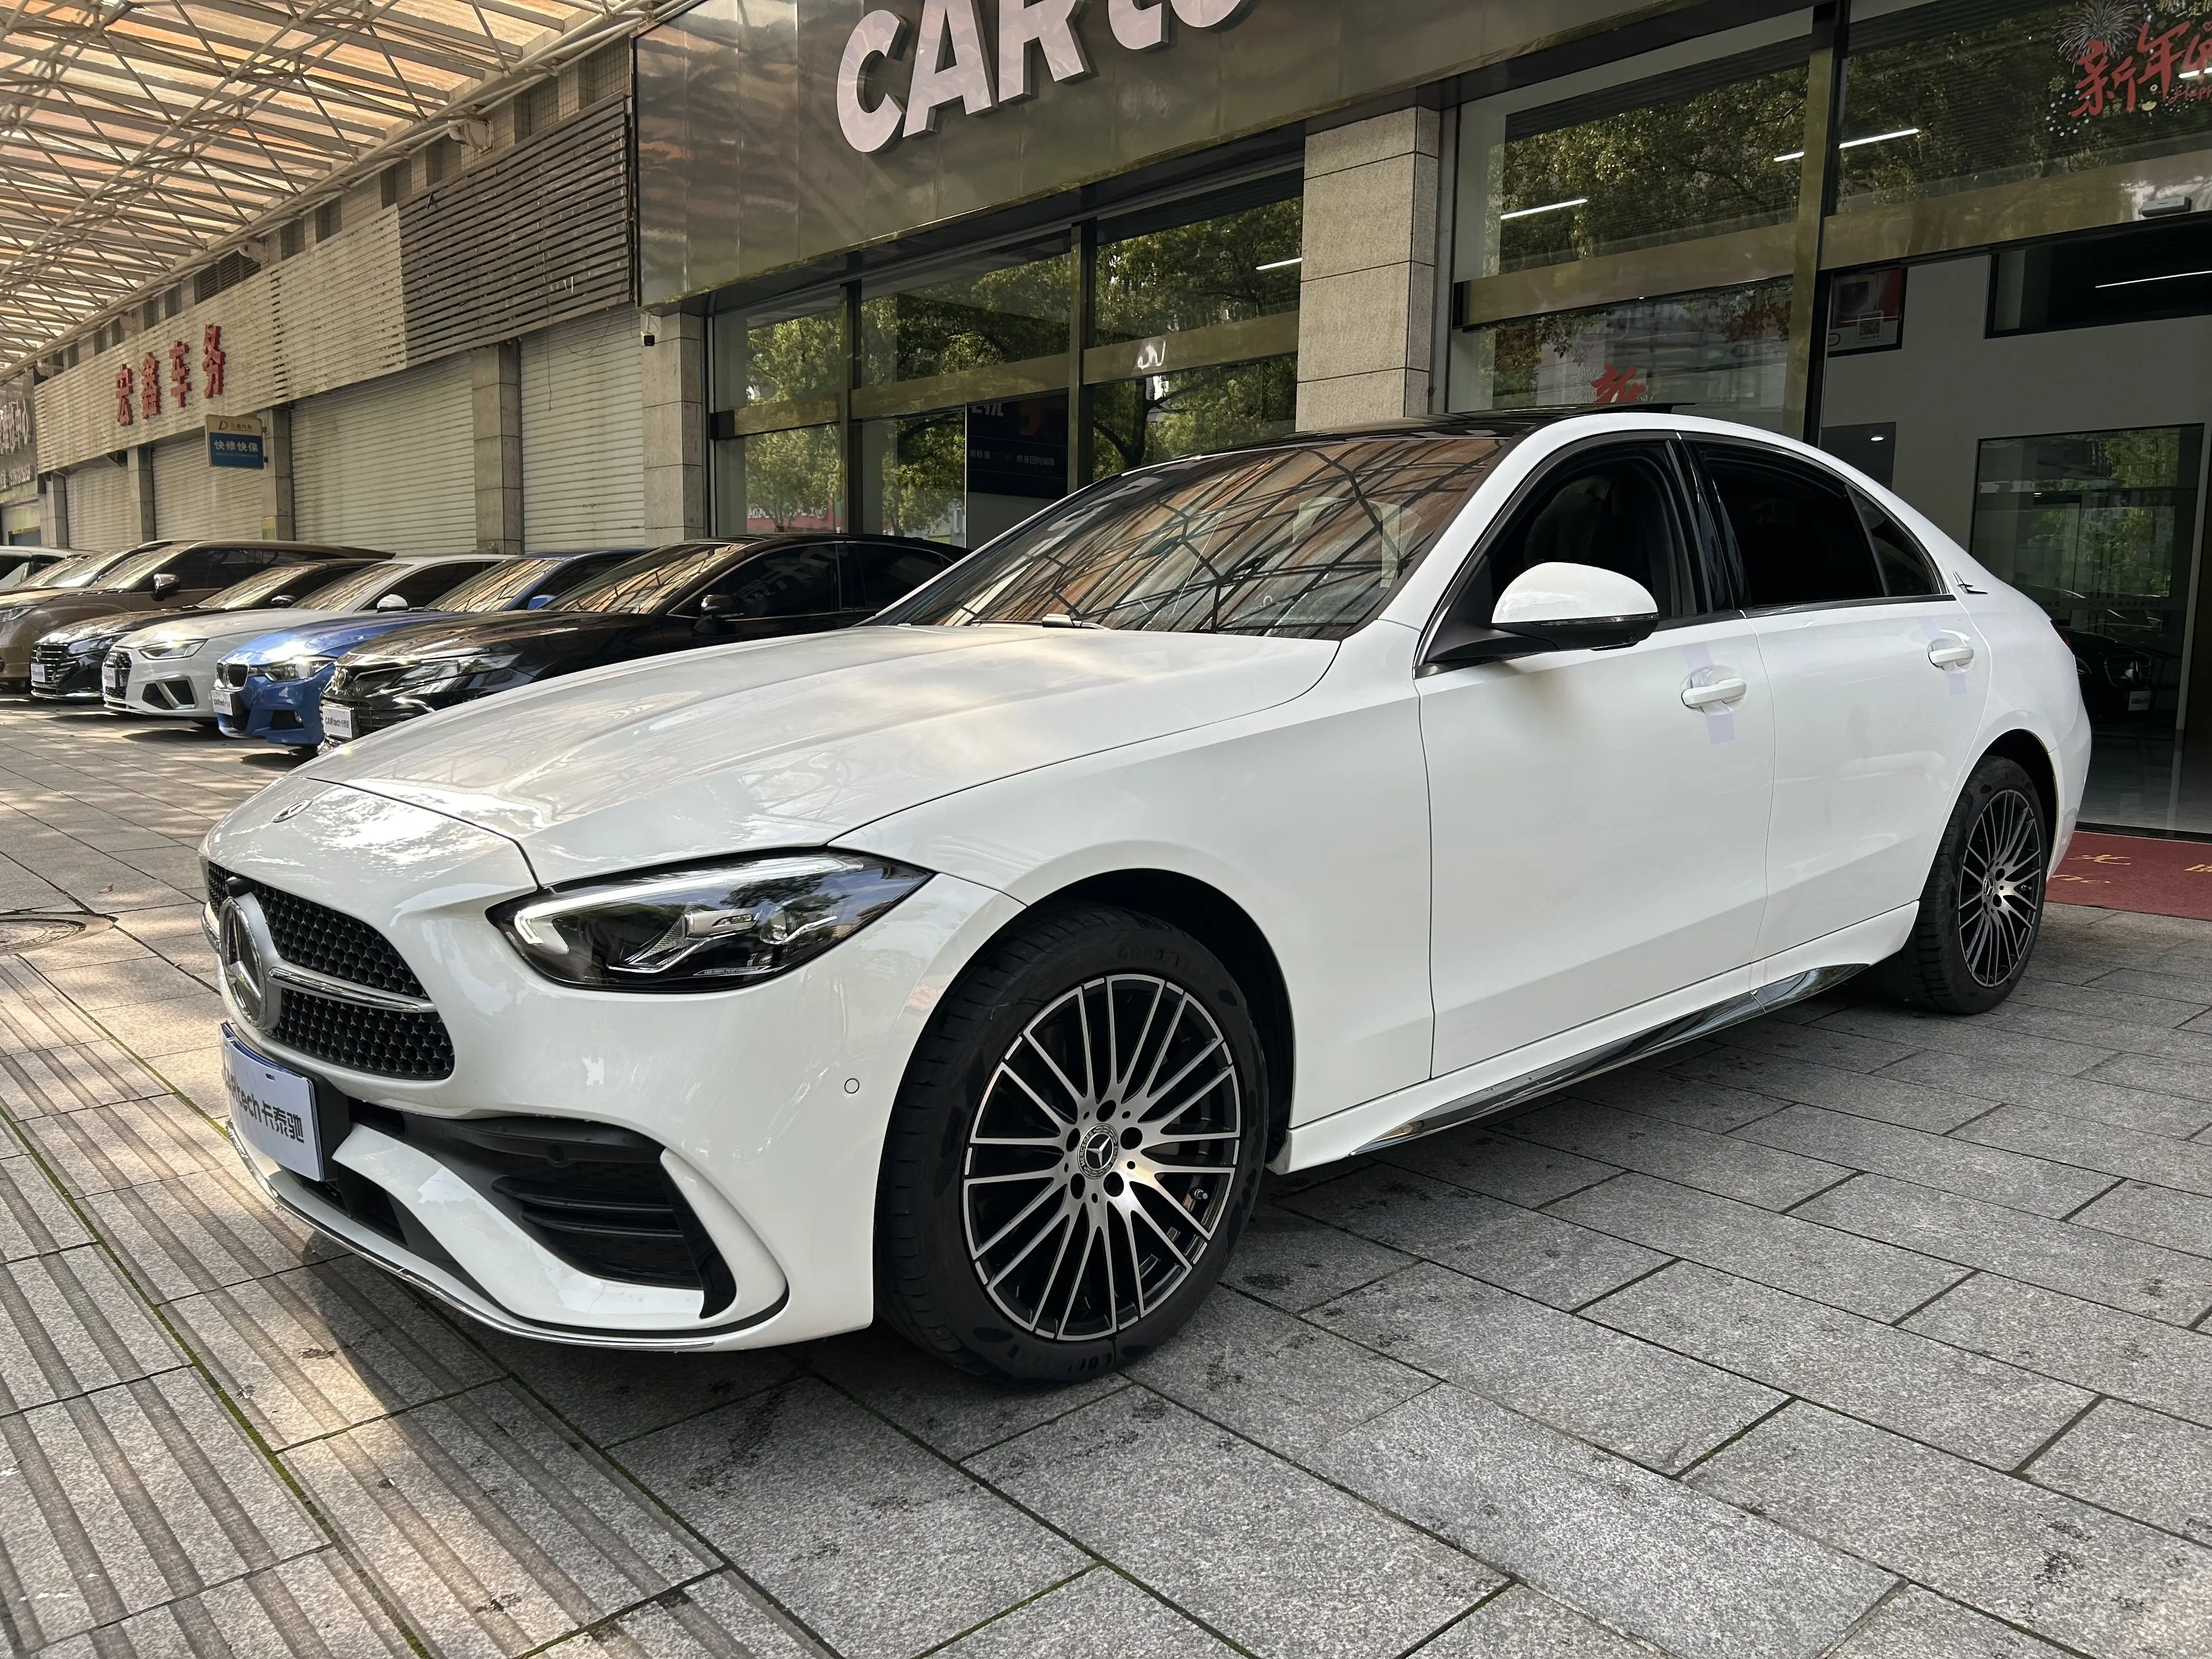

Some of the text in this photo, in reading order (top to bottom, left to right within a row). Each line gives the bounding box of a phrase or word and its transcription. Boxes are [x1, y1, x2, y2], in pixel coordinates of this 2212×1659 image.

[214, 439, 258, 453] 快修快保
[1079, 1131, 1094, 1167] MERCEDES
[1110, 1144, 1119, 1164] BENZ
